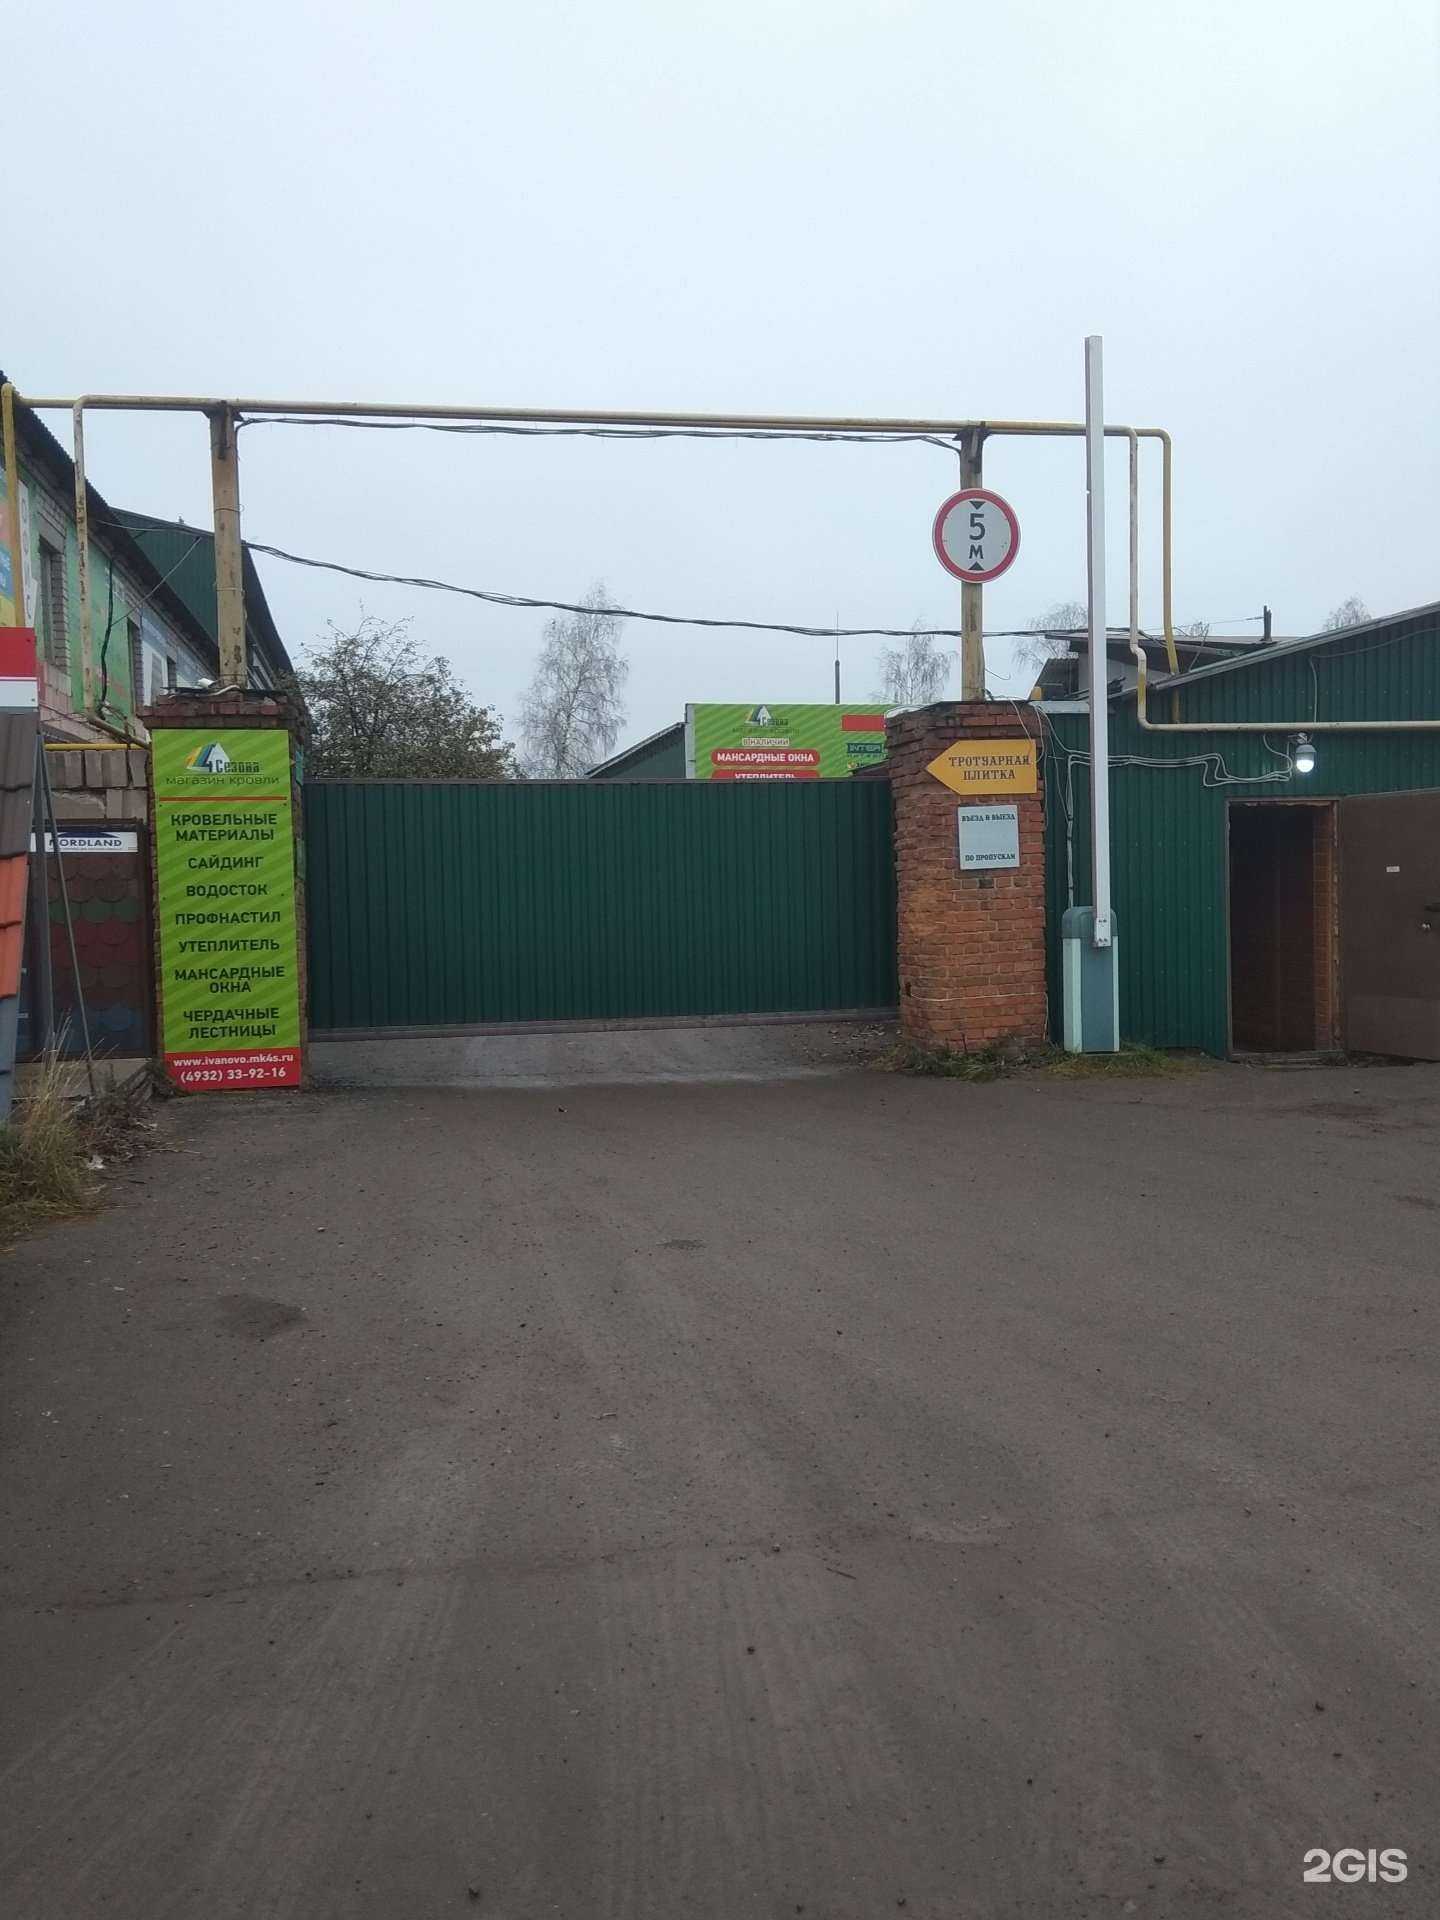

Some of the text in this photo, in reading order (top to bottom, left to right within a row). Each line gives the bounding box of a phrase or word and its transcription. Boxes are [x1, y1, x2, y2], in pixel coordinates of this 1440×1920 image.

[969, 513, 986, 540] 5
[717, 752, 815, 763] МАНСАРДНЫЕ ОКНА
[949, 755, 1029, 767] ТРОТУАРНАЯ
[215, 759, 260, 773] Сезона
[166, 776, 280, 786] магазин кровли
[963, 769, 1016, 780] ПЛИТКА
[171, 813, 278, 826] КРОВЕЛЬНЫЕ
[176, 829, 274, 841] МАТЕРИАЛЫ
[188, 855, 264, 871] САЙДИНГ
[976, 853, 1016, 861] ПРОПУСКАМ
[186, 884, 268, 898] ВОДОСТОК
[175, 911, 281, 925] ПРОФНАСТИЛ
[179, 939, 280, 953] УТЕПЛИТЕЛЬ
[175, 966, 285, 981] МАНСАРДНЫЕ
[209, 981, 251, 993] ОКНА
[184, 1008, 279, 1023] ЧЕРДАЧНЫЕ
[188, 1024, 276, 1039] ЛЕСТНИЦЫ
[174, 1054, 294, 1067] www.ivanovo.mk4s.ru
[180, 1067, 287, 1083] (4932) 33-92-16
